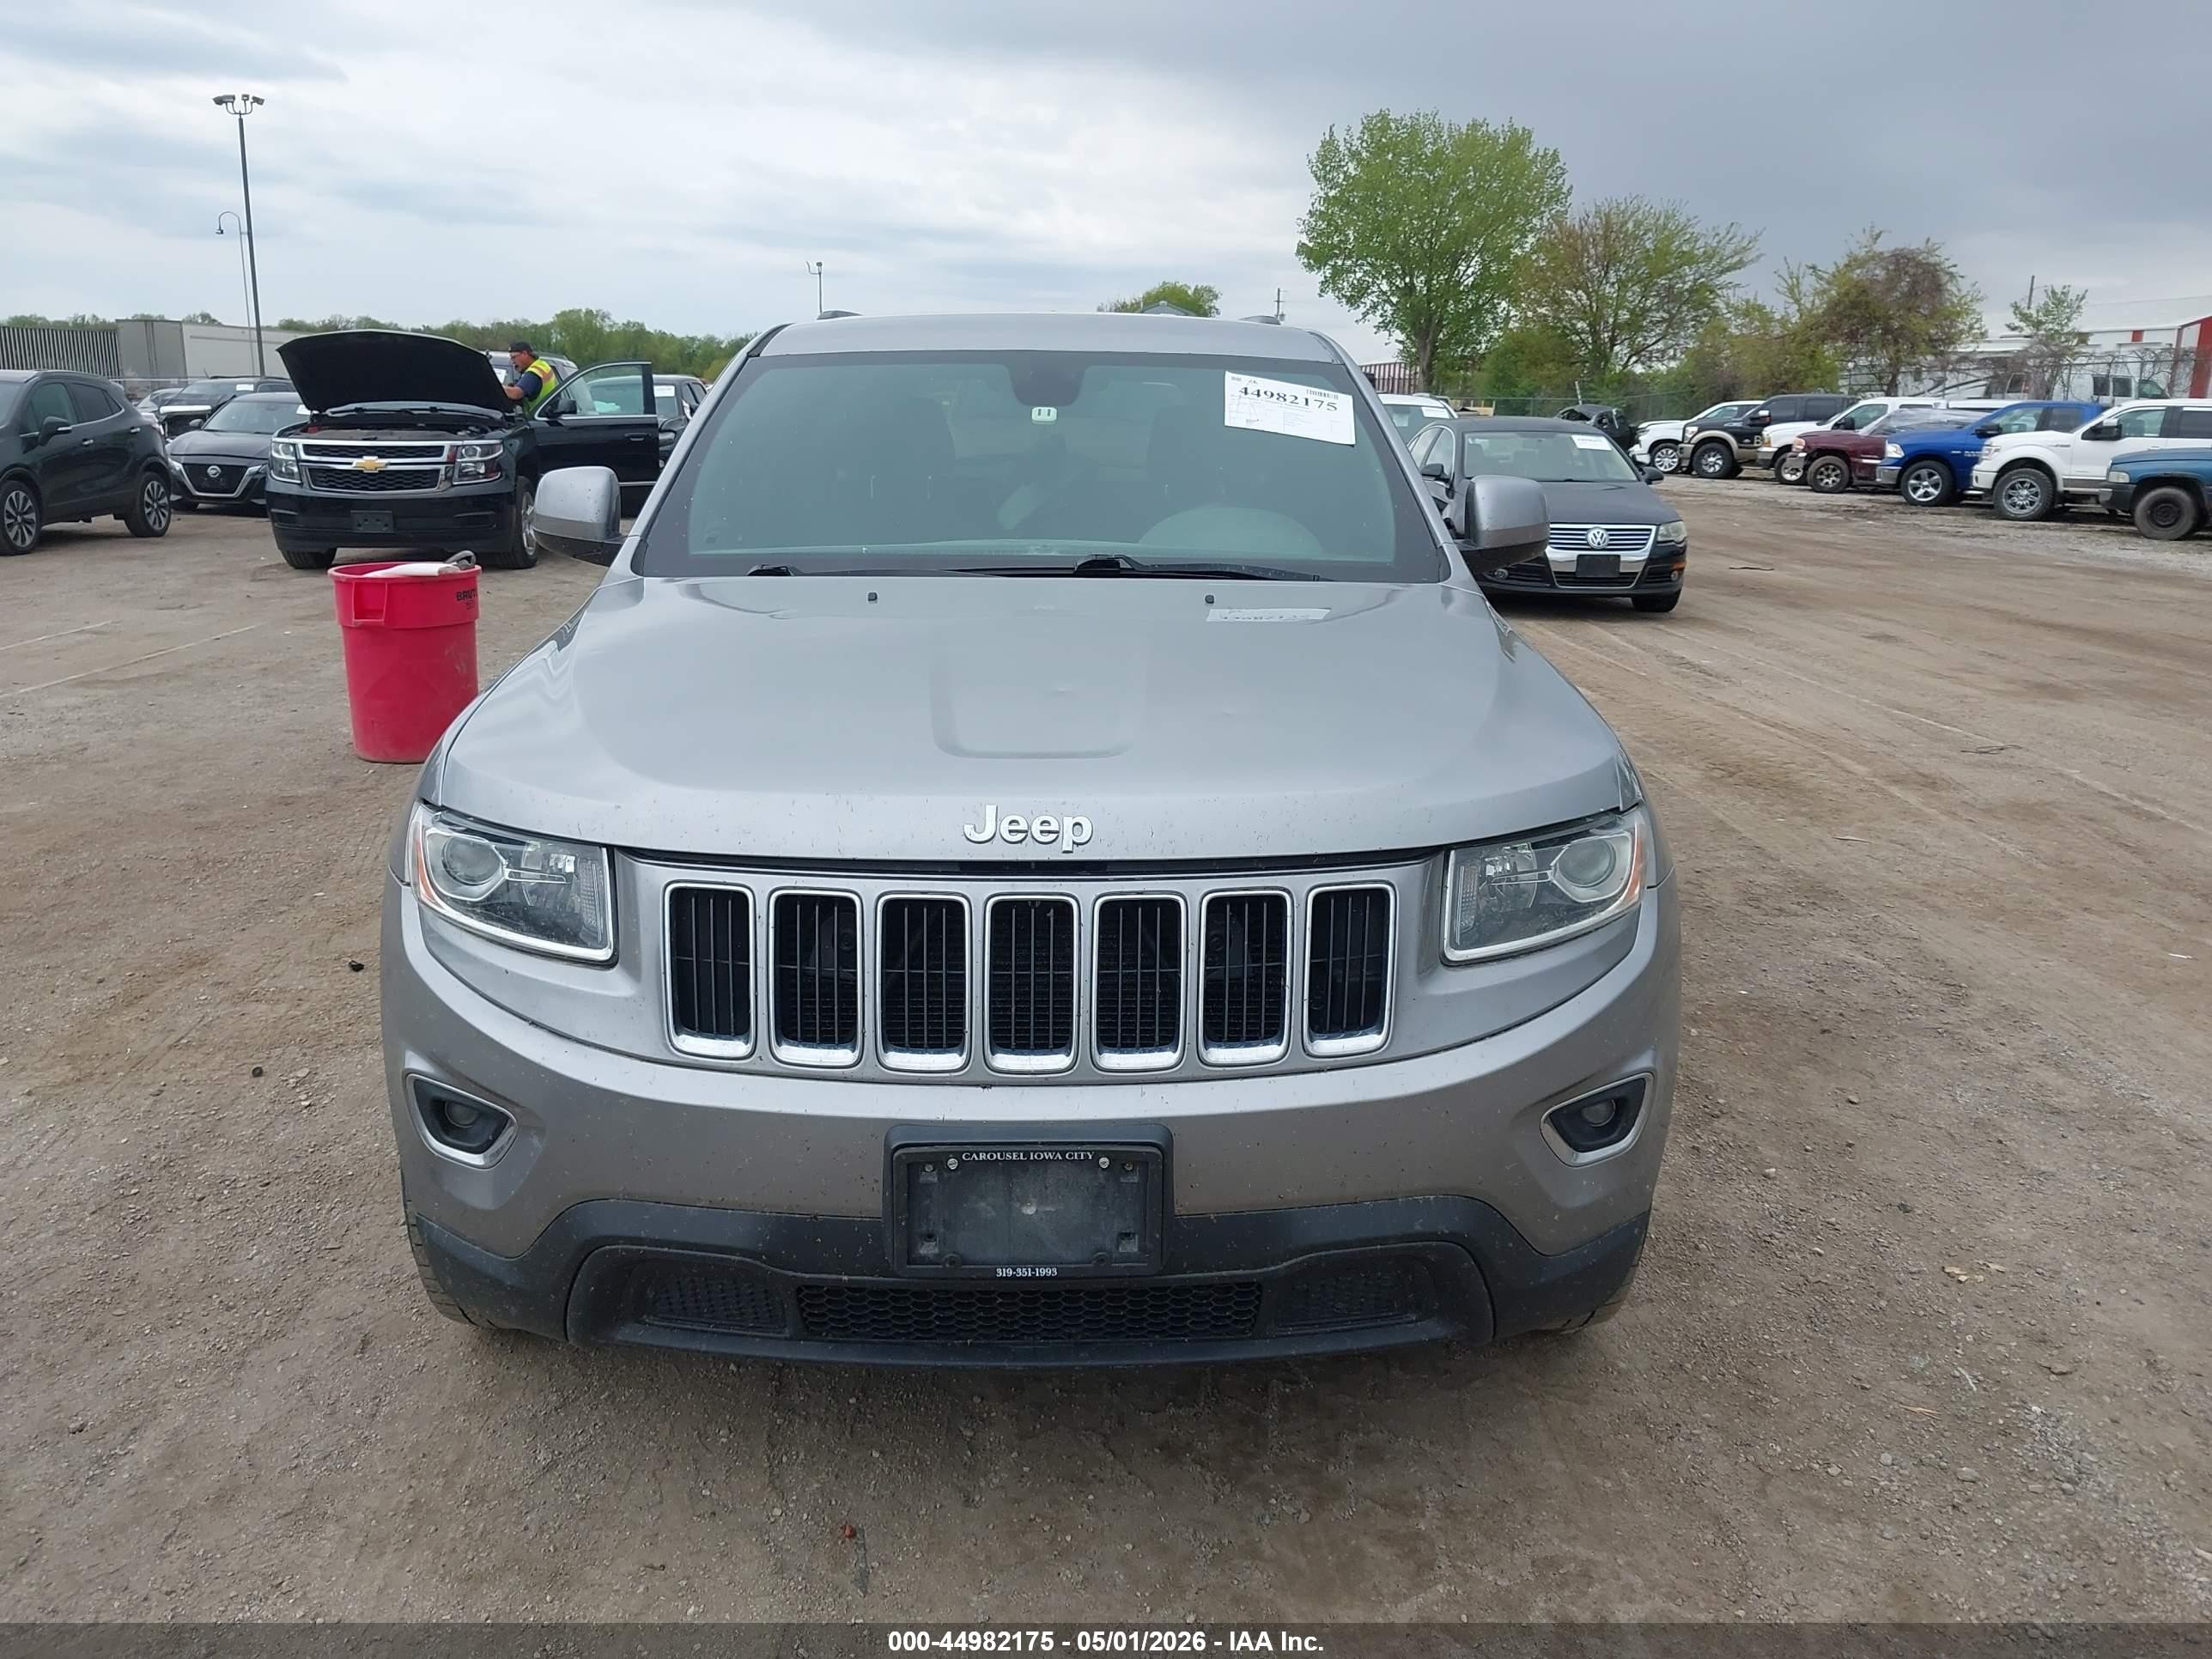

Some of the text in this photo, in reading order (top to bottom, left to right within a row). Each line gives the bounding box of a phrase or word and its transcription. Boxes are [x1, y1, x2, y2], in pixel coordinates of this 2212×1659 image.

[1239, 386, 1338, 412] 44982175
[963, 804, 1094, 854] Jeep
[962, 1151, 1095, 1161] CAROUSEL IOWA CITY
[995, 1267, 1058, 1278] 319-351-1993
